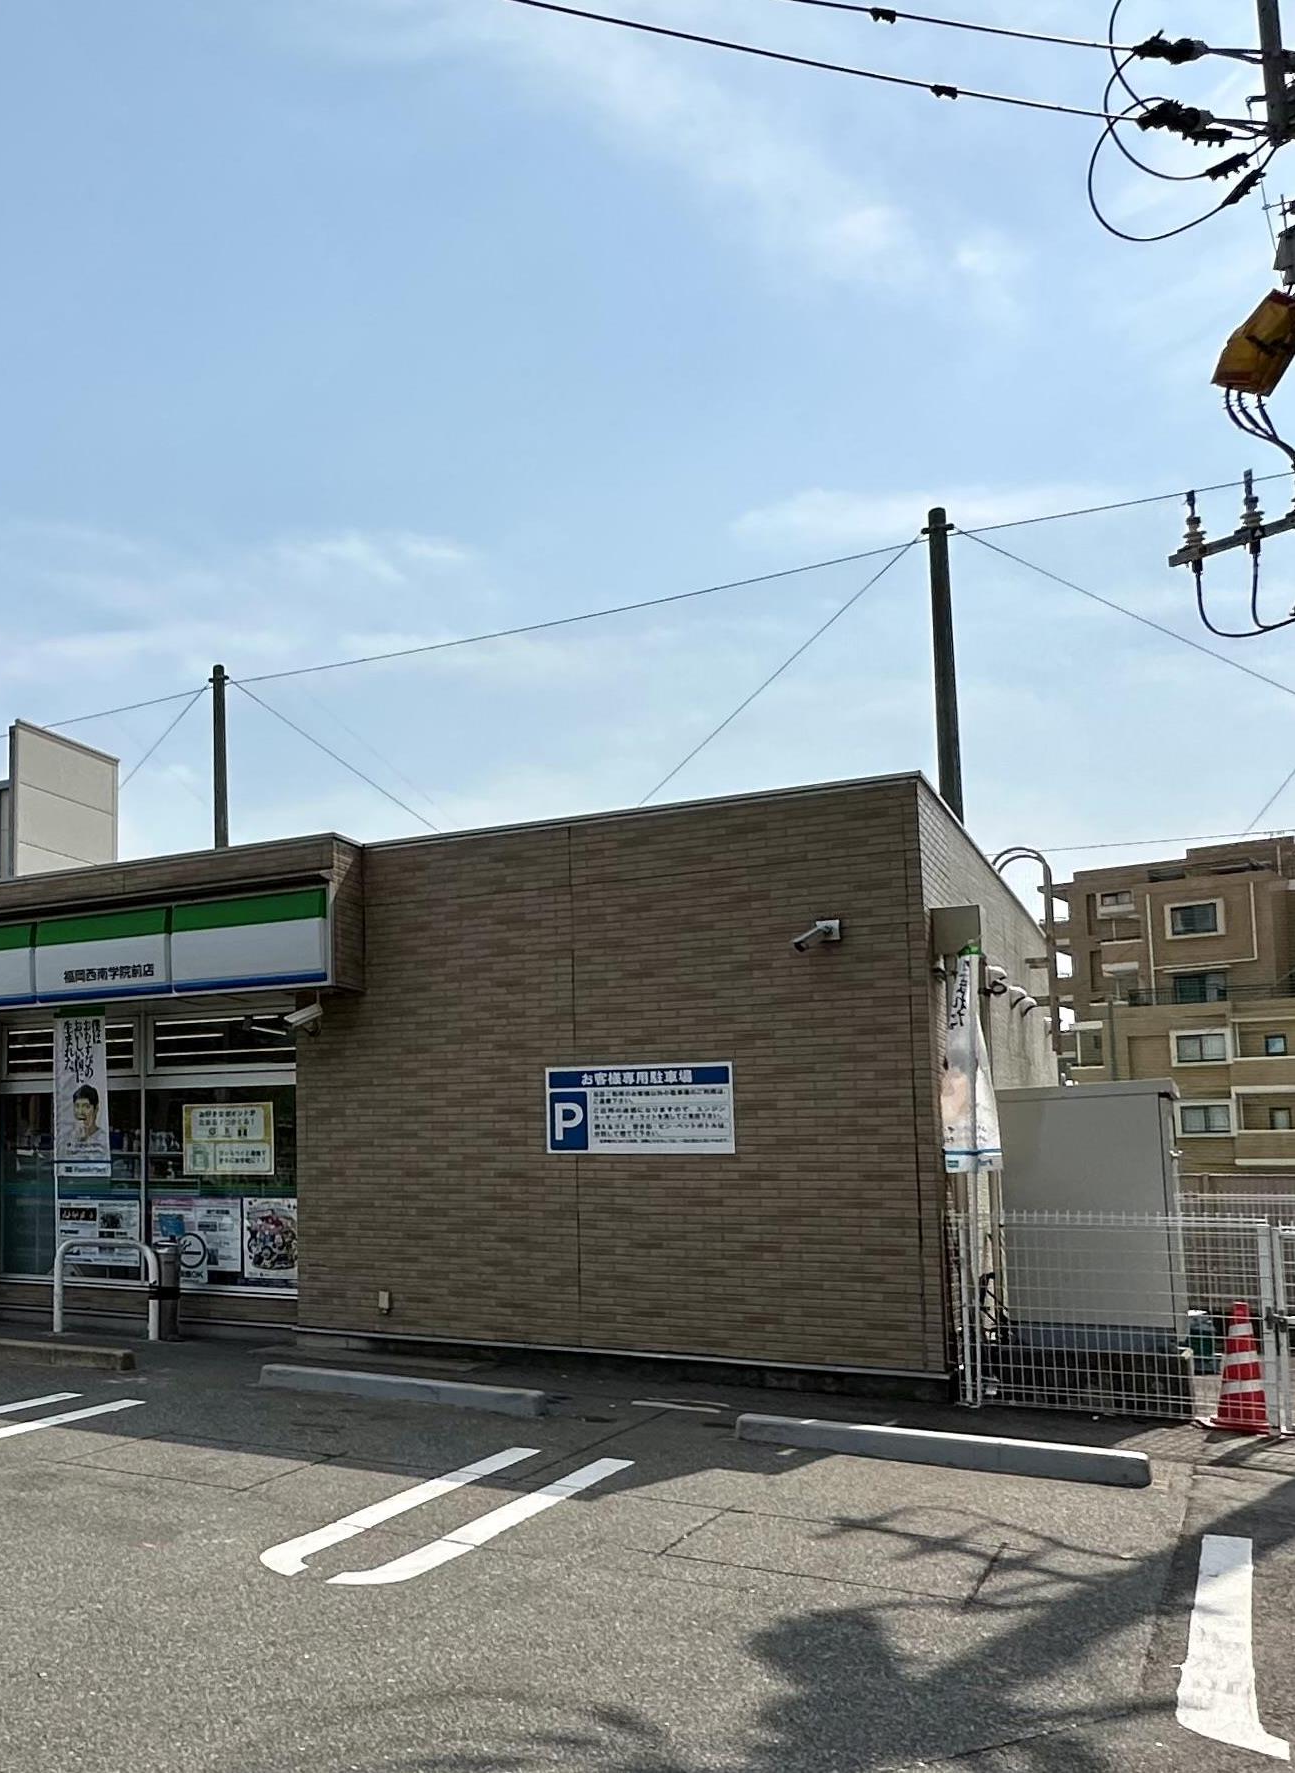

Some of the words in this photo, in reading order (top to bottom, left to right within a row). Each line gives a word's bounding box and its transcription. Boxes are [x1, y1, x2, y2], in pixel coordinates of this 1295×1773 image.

[63, 963, 154, 983] 福岡西南学院前店
[581, 1069, 693, 1086] お客様専用駐車場
[554, 1102, 583, 1141] P
